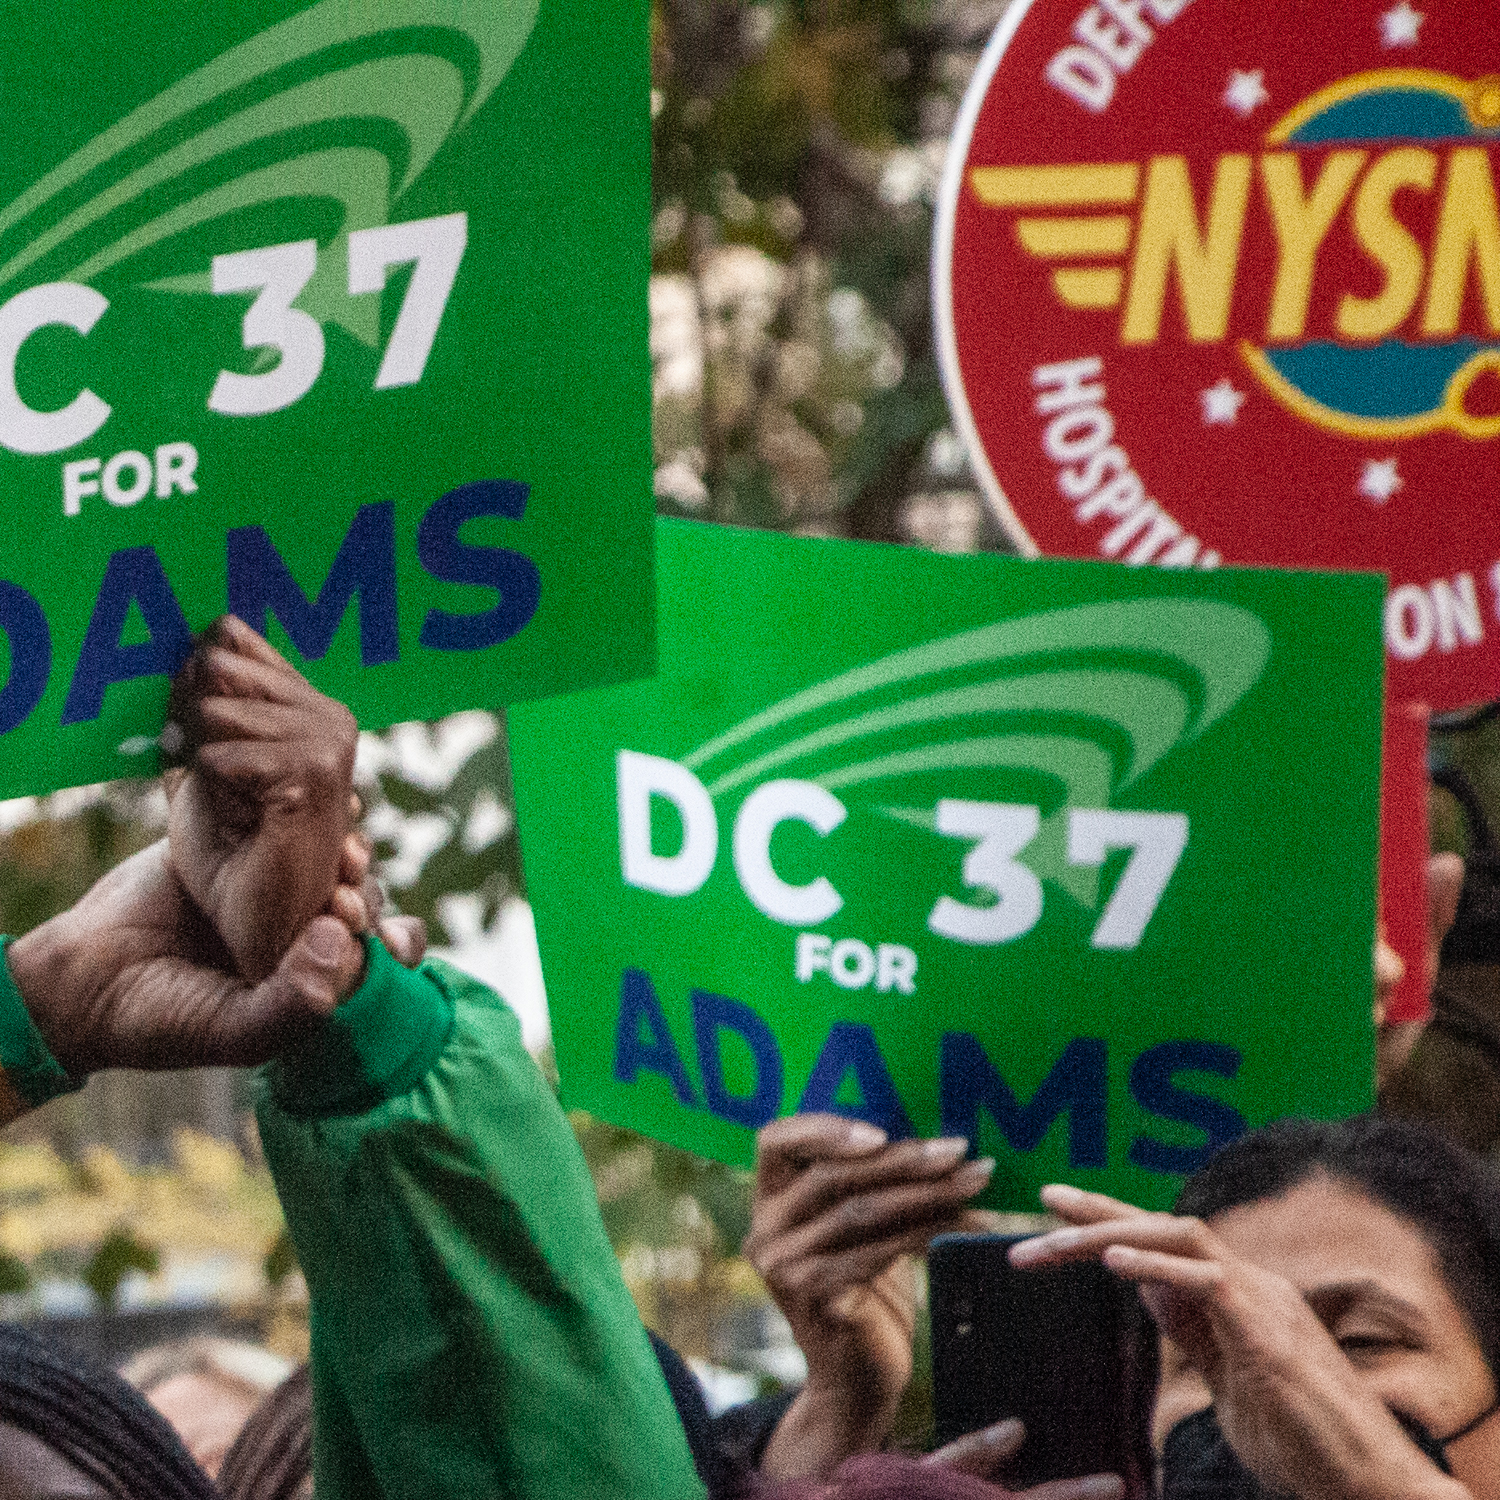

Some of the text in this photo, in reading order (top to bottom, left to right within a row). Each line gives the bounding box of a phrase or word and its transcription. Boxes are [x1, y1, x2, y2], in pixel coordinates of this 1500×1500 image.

[206, 211, 469, 417] 37
[61, 441, 199, 517] FOR
[616, 748, 1191, 950] DC 37
[796, 933, 919, 995] FOR
[612, 966, 1250, 1177] ADAMS
